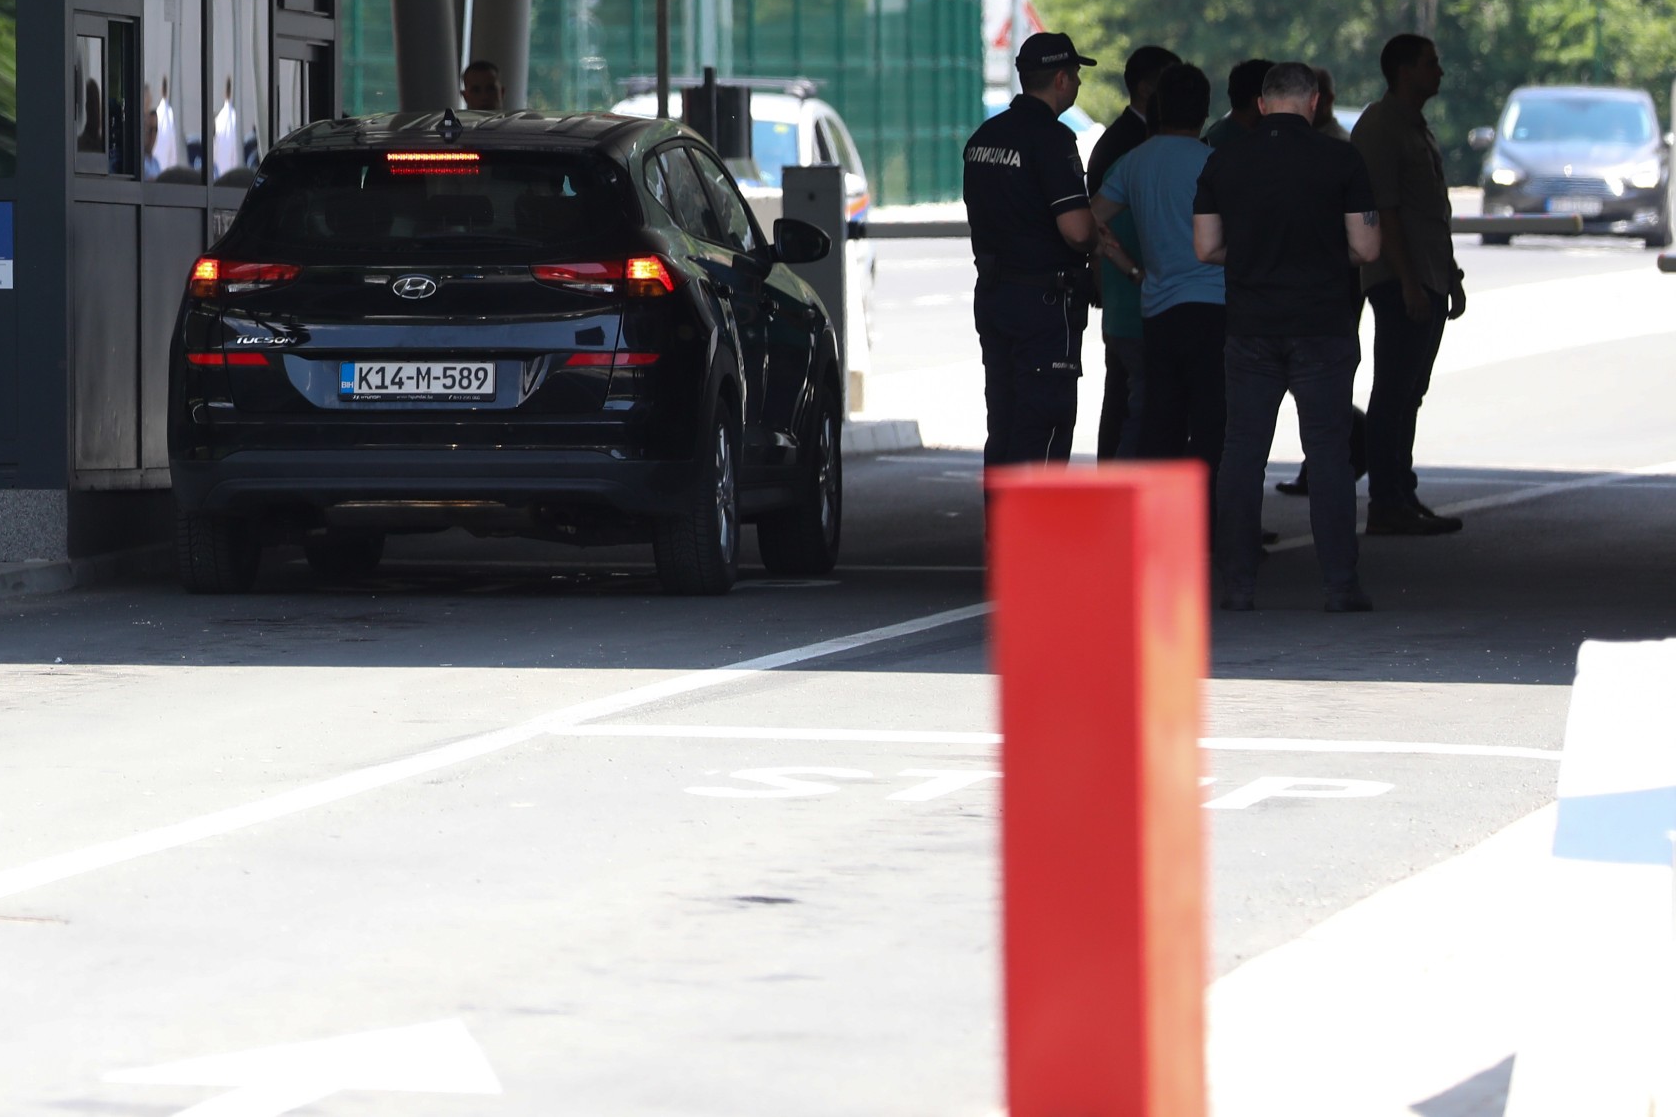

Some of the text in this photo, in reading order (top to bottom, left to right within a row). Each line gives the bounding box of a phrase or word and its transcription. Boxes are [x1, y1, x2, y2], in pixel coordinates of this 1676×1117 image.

[967, 146, 1021, 168] ОЛИЦИЈА
[236, 334, 297, 344] TUCSON
[358, 366, 489, 390] K14-M-589
[683, 766, 1396, 810] STP
